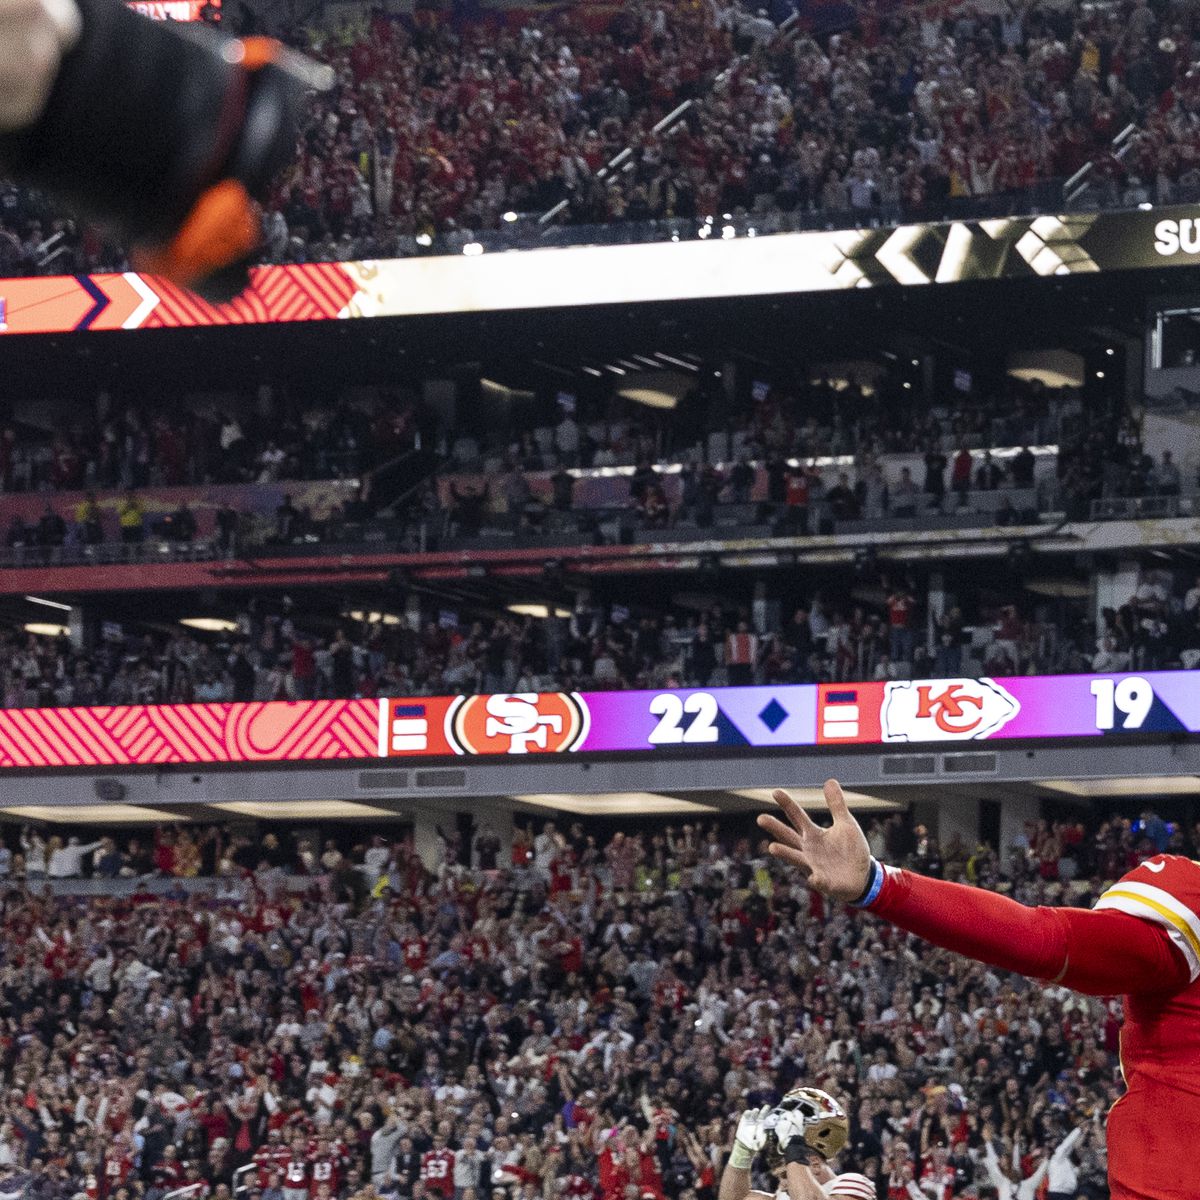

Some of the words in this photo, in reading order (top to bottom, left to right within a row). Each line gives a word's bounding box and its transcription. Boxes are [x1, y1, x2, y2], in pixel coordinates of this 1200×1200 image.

[648, 692, 719, 744] 22
[915, 684, 984, 734] KC
[1090, 676, 1155, 729] 19
